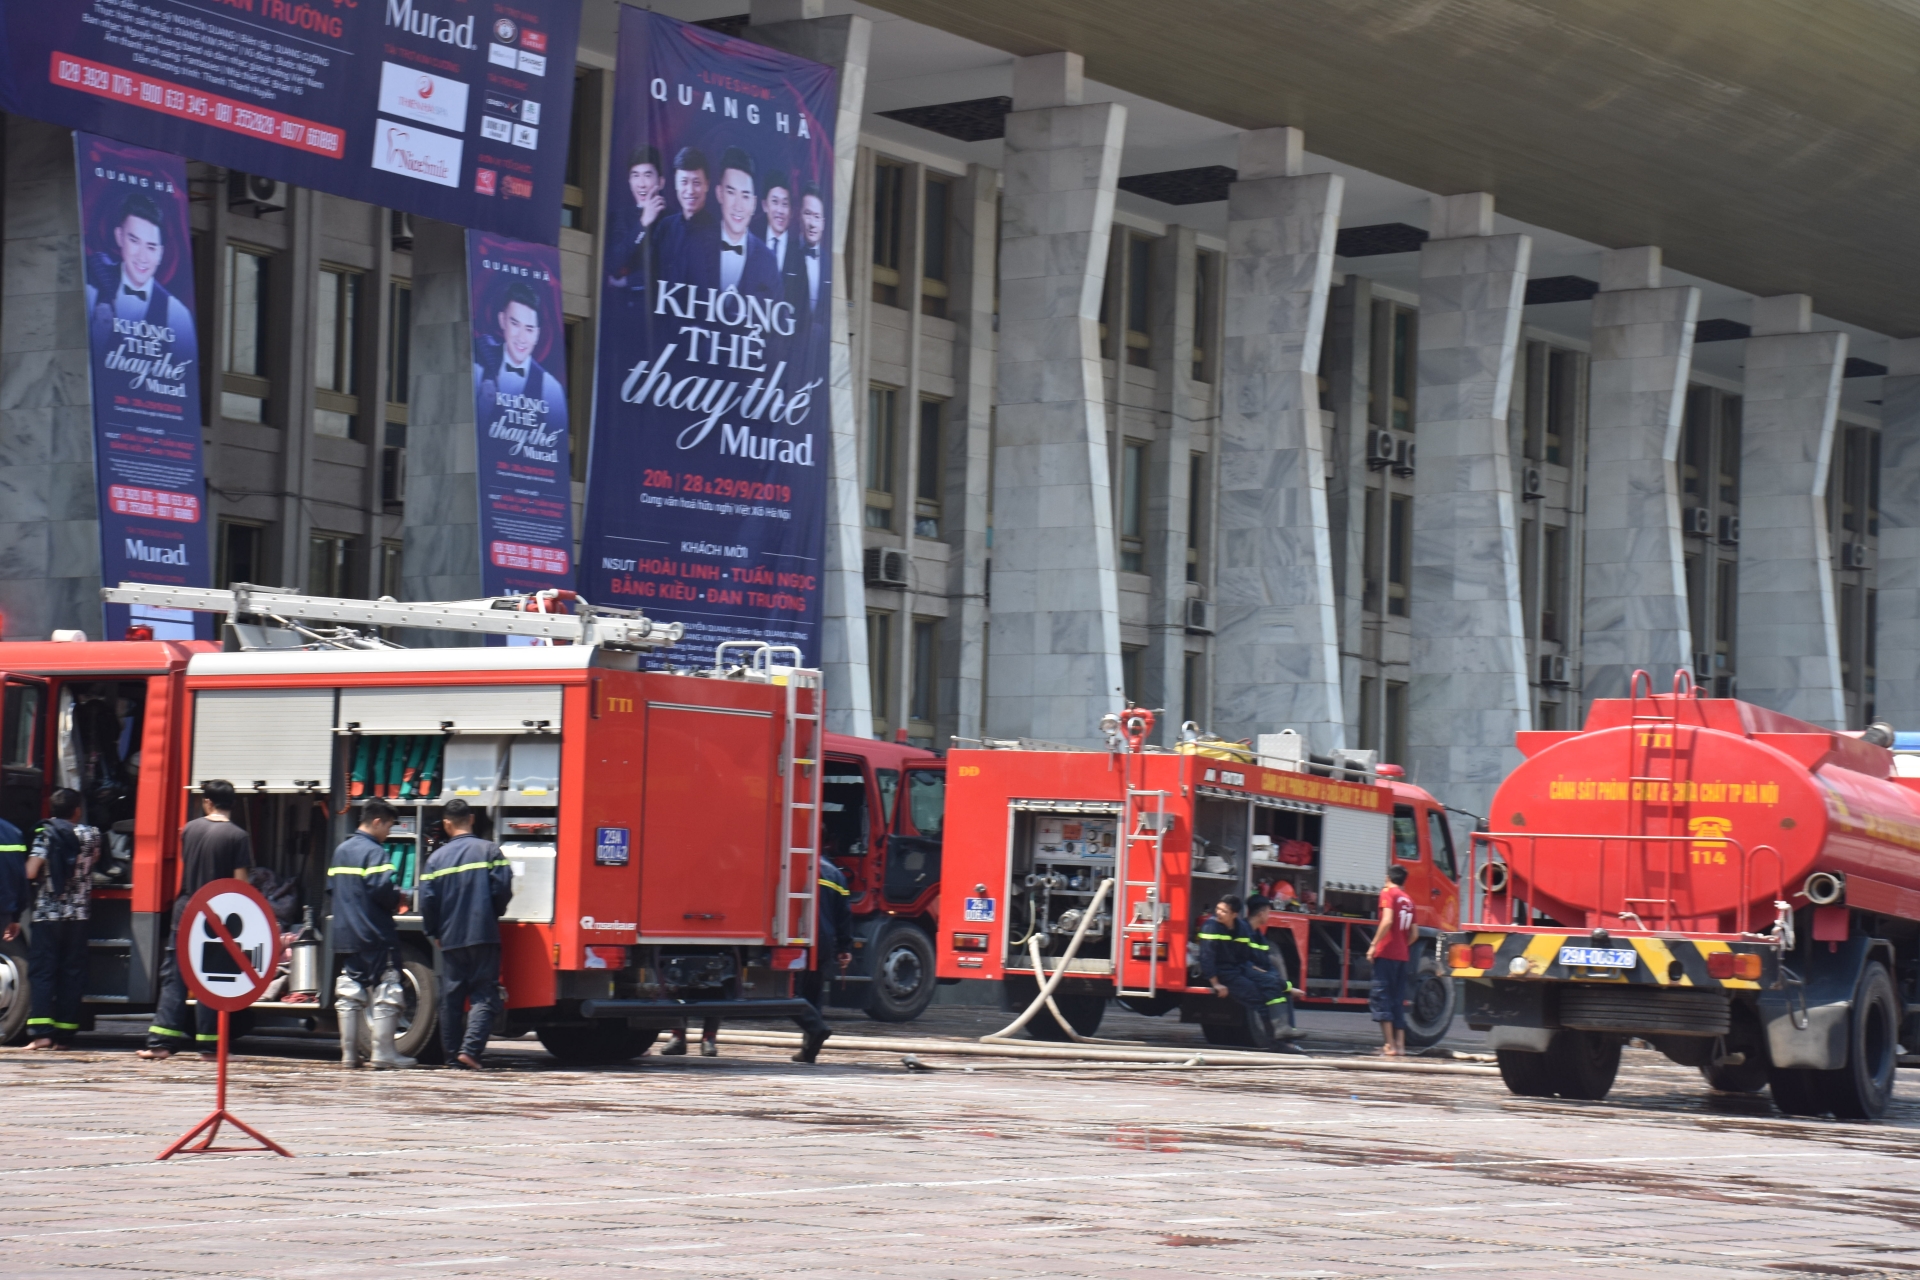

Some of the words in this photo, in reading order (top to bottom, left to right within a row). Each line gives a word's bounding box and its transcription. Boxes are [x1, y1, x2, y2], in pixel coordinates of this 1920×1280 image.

[650, 77, 760, 125] QUANG
[775, 111, 811, 139] HÀ
[95, 167, 150, 188] QUANG
[482, 259, 528, 277] QUANG
[654, 280, 797, 336] KHÔNG
[113, 317, 176, 343] KHÔNG
[678, 323, 767, 373] THỂ
[495, 391, 550, 415] KHÔNG
[620, 343, 742, 450] thay
[740, 361, 824, 426] thế
[642, 469, 673, 489] 20h
[681, 541, 722, 556] KHÁCH
[638, 557, 677, 576] HOÀI
[681, 563, 720, 580] LINH
[730, 565, 773, 585] TUẤN
[777, 573, 816, 592] NGỌC
[706, 588, 742, 605] ĐAN
[1637, 732, 1673, 748] TT1
[1550, 774, 1577, 800] CẢNH
[1578, 778, 1597, 800] SÁT
[1661, 781, 1670, 801] &
[1701, 780, 1727, 803] CHÁY
[1743, 781, 1758, 803] HÀ
[1759, 781, 1779, 807] NỘI
[604, 830, 622, 844] 29A
[1690, 850, 1727, 865] 114
[1399, 910, 1413, 930] 11
